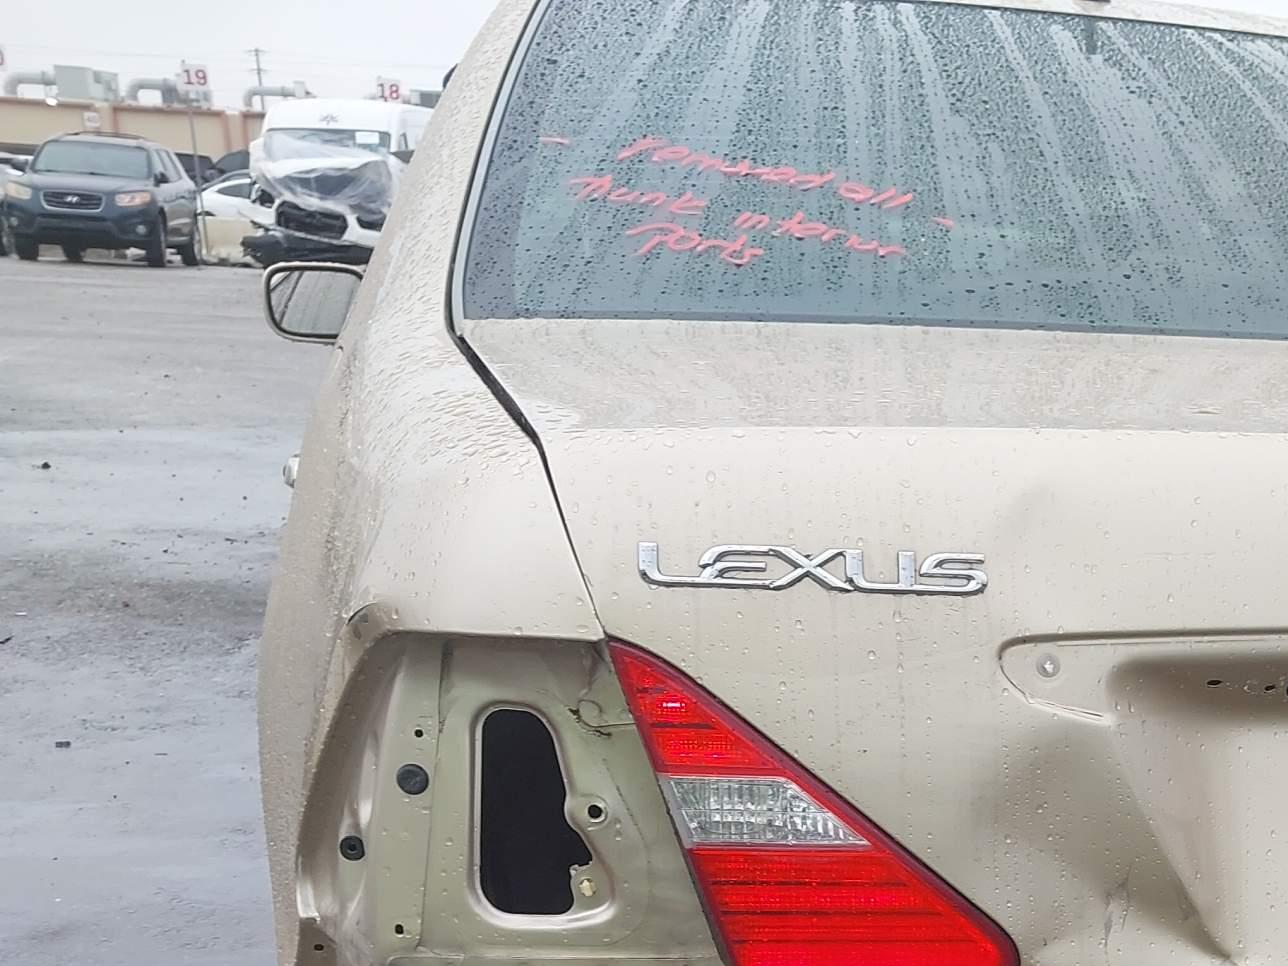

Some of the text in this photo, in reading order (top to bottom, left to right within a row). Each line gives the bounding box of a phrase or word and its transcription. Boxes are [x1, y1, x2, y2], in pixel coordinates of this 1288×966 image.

[183, 69, 208, 86] 19
[378, 83, 400, 101] 18
[638, 541, 988, 596] LEXUS
